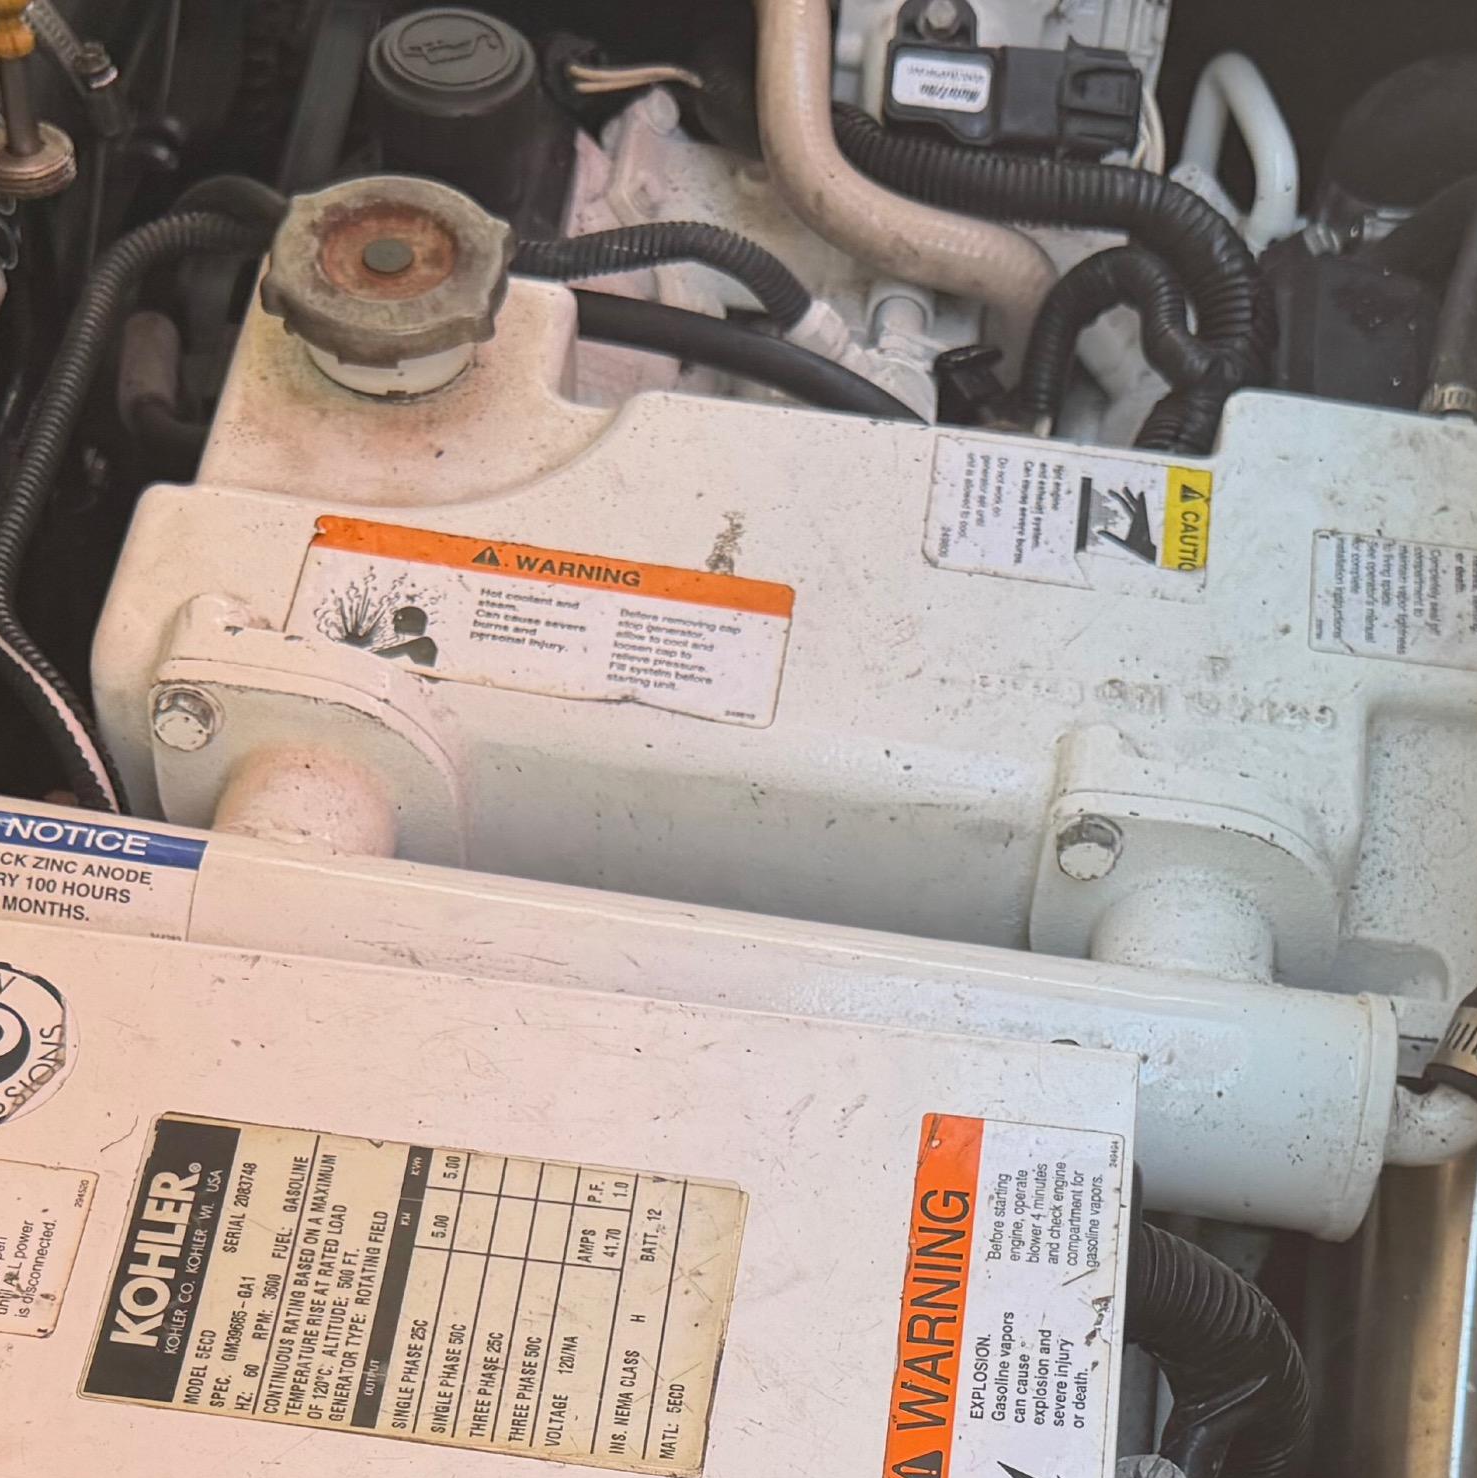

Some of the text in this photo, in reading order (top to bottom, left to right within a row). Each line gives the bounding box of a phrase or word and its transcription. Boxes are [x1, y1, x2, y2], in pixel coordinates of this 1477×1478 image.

[1021, 460, 1035, 477] Can
[479, 587, 580, 611] Hot coolant and
[514, 553, 642, 588] WARNING
[469, 629, 569, 655] personal injury.
[619, 607, 742, 636] Before removing cap
[2, 815, 151, 857] NOTICE
[24, 875, 58, 894] 100
[60, 881, 133, 904] HOURS
[31, 855, 78, 875] ZINC
[80, 862, 153, 885] ANODE
[0, 895, 92, 922] MONTHS.
[441, 1154, 462, 1180] 5.00
[220, 1160, 260, 1254] SERIAL 2083748
[429, 1213, 451, 1239] 5.00
[645, 1207, 664, 1222] 12
[986, 1172, 1013, 1260] Before starting
[1006, 1168, 1032, 1262] engine, operate
[1025, 1161, 1049, 1264] blower 4 minutes
[1044, 1160, 1070, 1265] and check engine
[1063, 1170, 1086, 1267] compartment for
[1081, 1172, 1106, 1269] gasoline vapors.
[11, 1219, 40, 1260] power
[13, 1217, 60, 1318] is disconnected.
[161, 1167, 225, 1355] KOHLER CO. KOHLER WI. USA
[340, 1246, 361, 1266] FT.
[574, 1227, 598, 1263] AMPS
[600, 1226, 623, 1258] 41.70
[0, 1259, 24, 1287] ALL
[232, 1154, 311, 1411] HZ: 60 RPM: 3600 FUEL: GASOLINE
[259, 1152, 340, 1415] CONTINUOUS RATING BASED ON A MAXIMUM
[335, 1267, 356, 1290] 500
[281, 1203, 349, 1417] TEMPERATURE RISE AT RATED LOAD
[319, 1294, 351, 1357] ALTITUDE:
[324, 1209, 390, 1422] GENERATOR TYPE: ROTATING FIELD
[629, 1312, 646, 1323] H
[896, 1188, 971, 1432] WARNING
[182, 1328, 217, 1405] MODEL 5ECD
[207, 1372, 233, 1408] SPEC.
[361, 1357, 382, 1396] OUTPUT
[388, 1318, 429, 1430] SINGLE PHASE 25C
[466, 1330, 505, 1439] THREE PHASE 25C
[541, 1333, 581, 1448] VOLTAGE 120/NA
[617, 1348, 642, 1388] CLASS
[966, 1331, 993, 1420] EXPLOSION.
[989, 1310, 1019, 1422] Gasoline vapors
[1011, 1352, 1031, 1424] can cause
[1028, 1327, 1053, 1426] explosion and
[1050, 1337, 1075, 1427] severe injury
[1069, 1366, 1089, 1429] or death.
[304, 1403, 325, 1420] OF
[610, 1390, 635, 1426] NEMA
[656, 1382, 687, 1461] MATL: 5ECD
[606, 1428, 629, 1455] INS.
